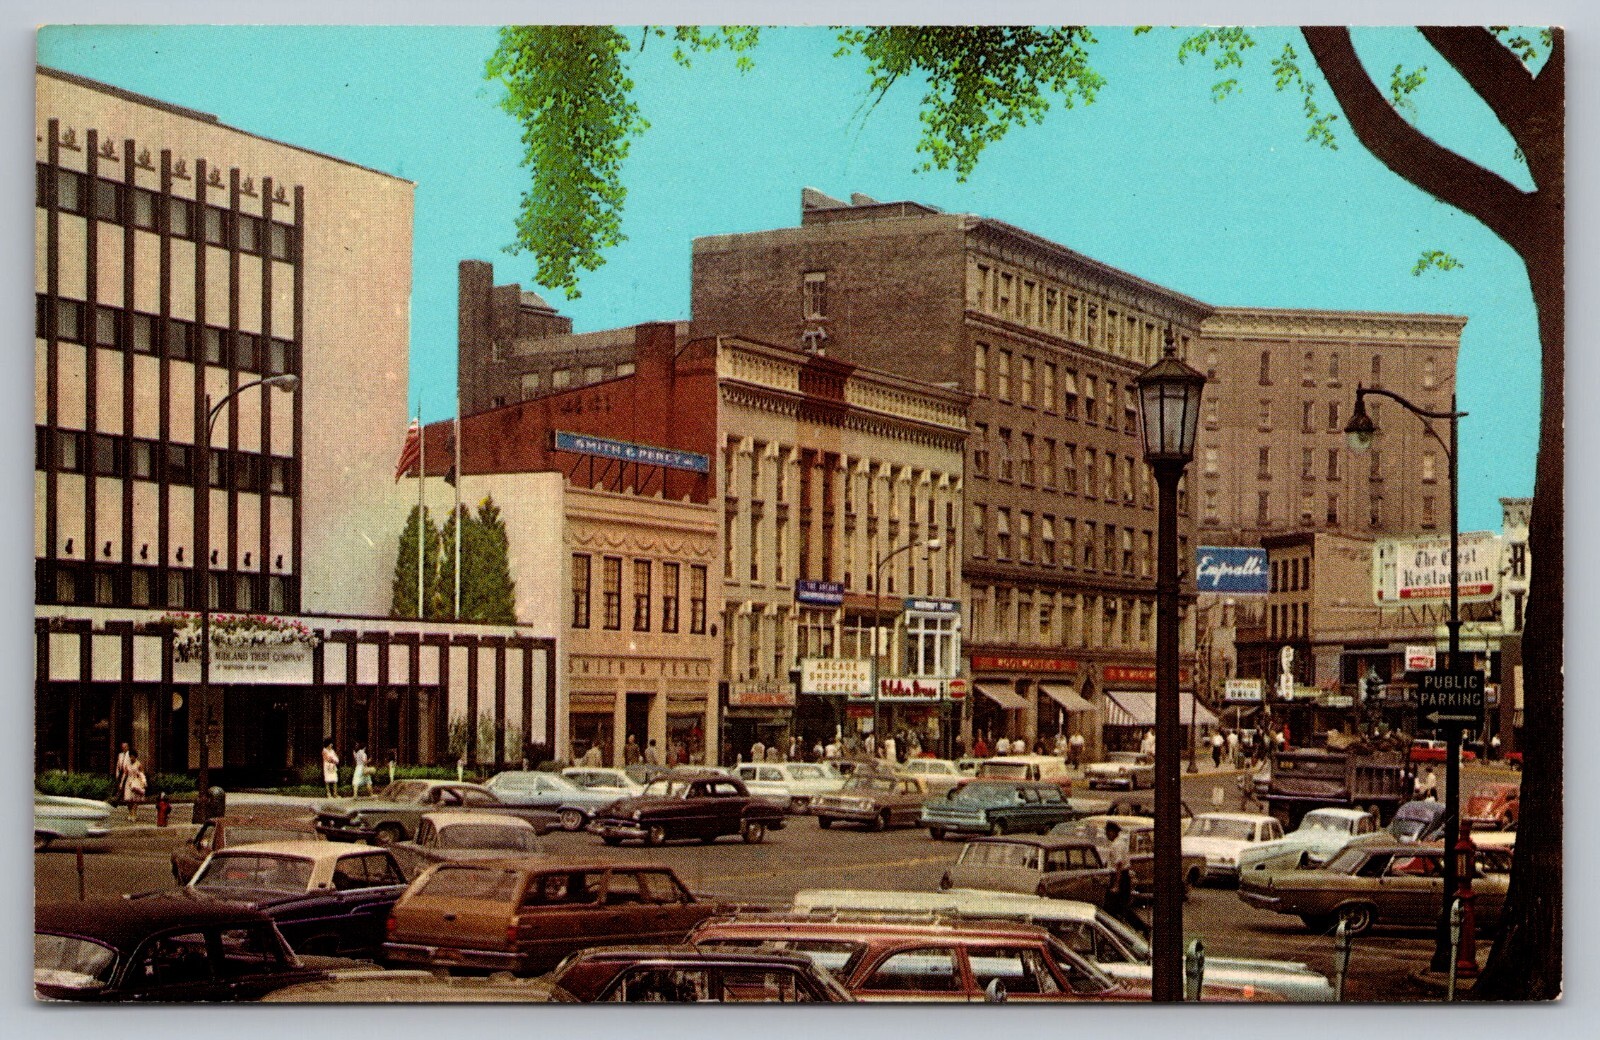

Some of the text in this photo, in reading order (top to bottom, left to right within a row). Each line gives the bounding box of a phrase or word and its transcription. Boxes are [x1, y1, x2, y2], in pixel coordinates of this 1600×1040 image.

[816, 661, 858, 670] ARCADE
[809, 671, 867, 681] SHOPPING
[816, 682, 858, 692] CENTER
[1424, 675, 1478, 689] PUBLIC
[1420, 692, 1481, 706] PARKING
